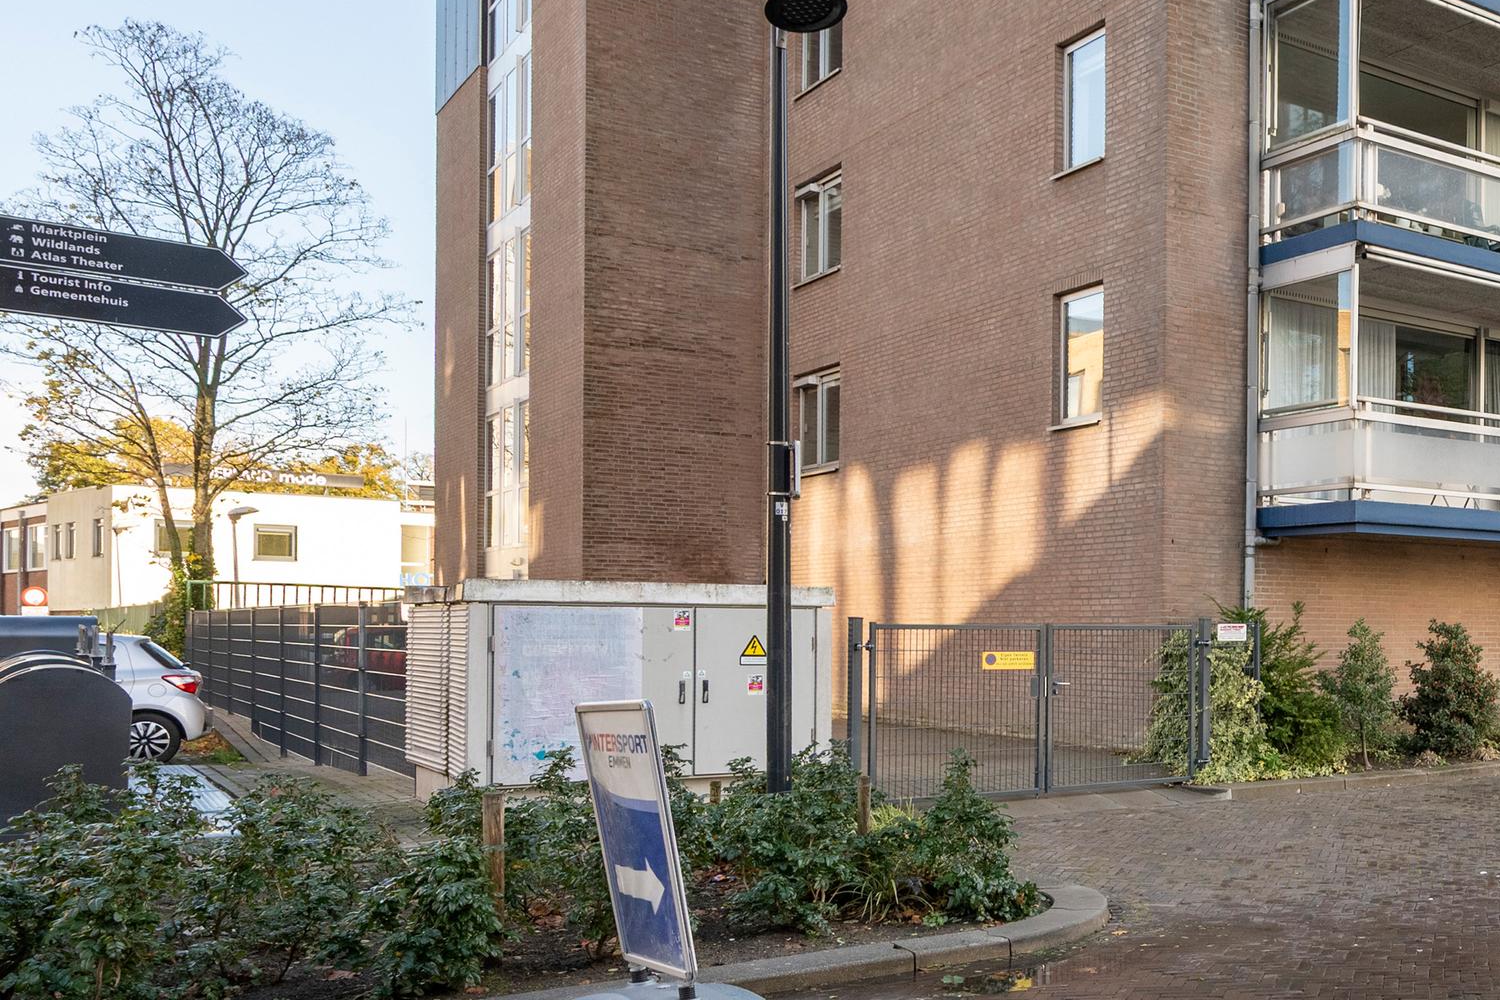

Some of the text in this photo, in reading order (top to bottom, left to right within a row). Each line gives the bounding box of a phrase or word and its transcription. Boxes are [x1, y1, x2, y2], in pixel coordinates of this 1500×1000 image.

[31, 223, 108, 243] Marktplein
[31, 236, 101, 255] Wildlands
[31, 250, 124, 271] Atlas Theater
[31, 272, 112, 292] Tourist Info
[30, 285, 129, 307] Gemeentehuis
[279, 473, 327, 486] mode
[592, 733, 648, 754] INTERSPORT
